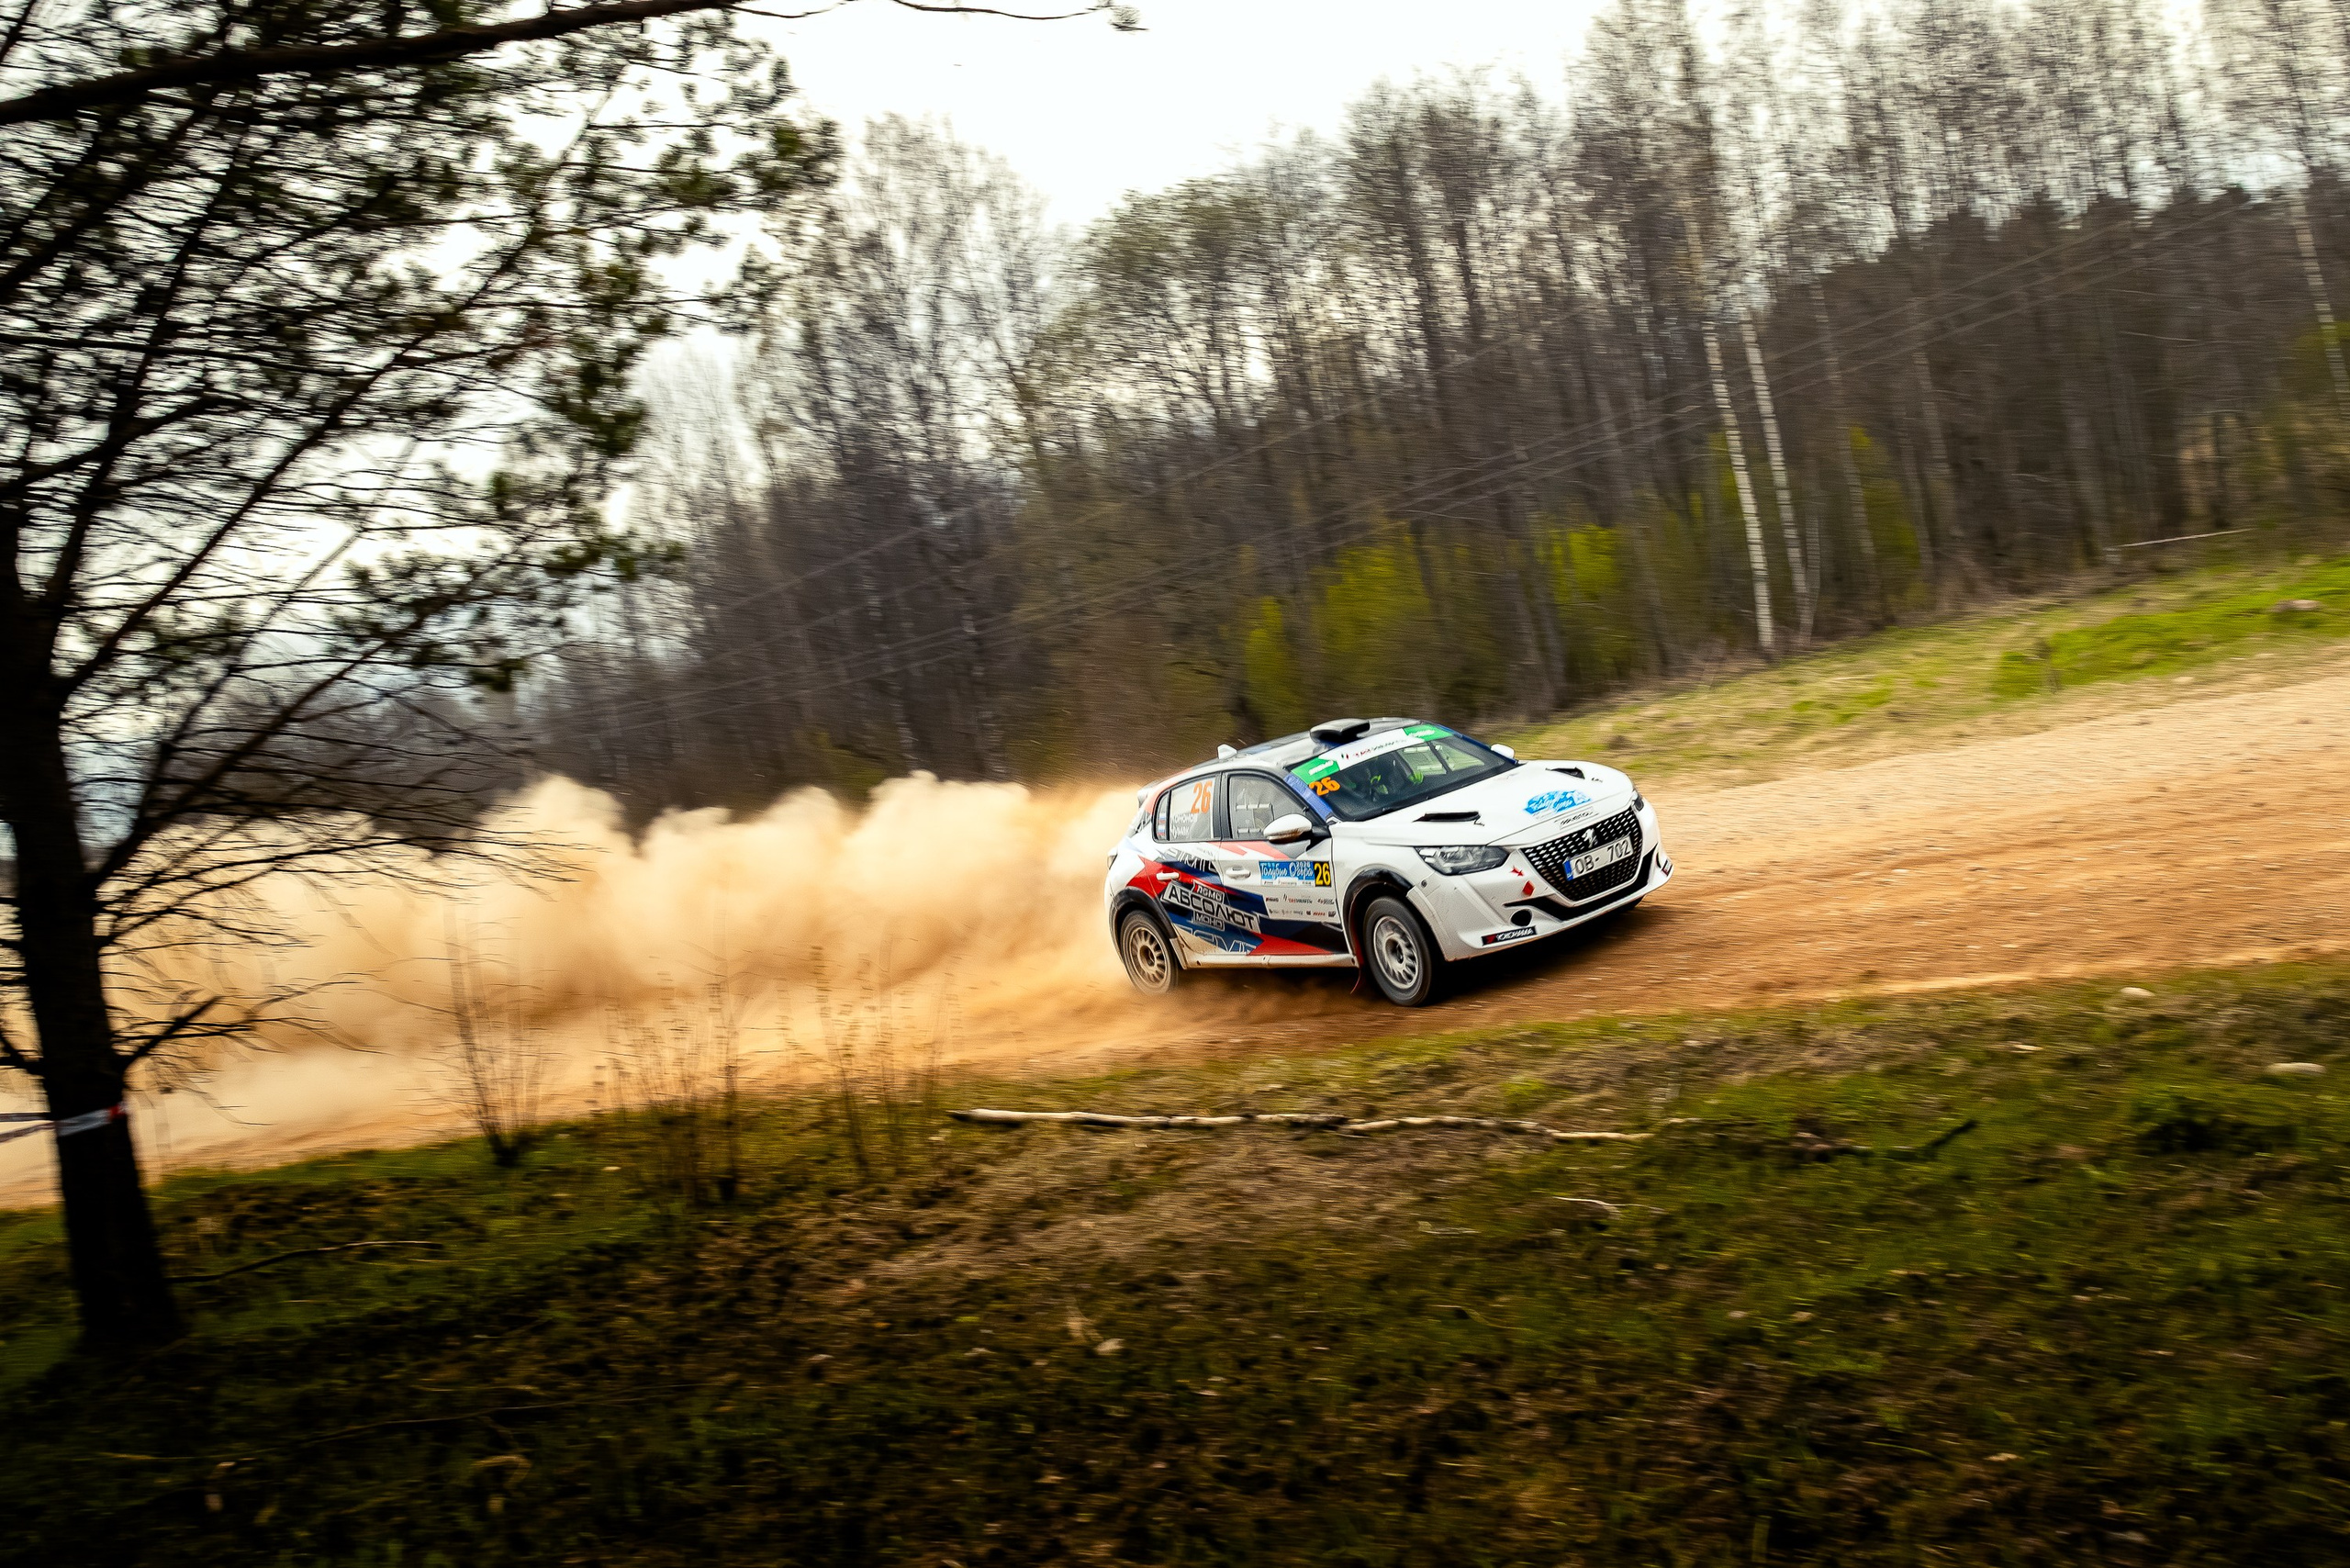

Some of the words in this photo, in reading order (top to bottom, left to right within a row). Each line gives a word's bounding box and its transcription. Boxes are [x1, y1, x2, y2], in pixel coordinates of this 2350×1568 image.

[1191, 780, 1213, 814] 26
[1309, 777, 1340, 796] 26
[1606, 839, 1631, 863] 702
[1314, 862, 1331, 886] 26
[1168, 885, 1255, 930] АБСОЛЮТ
[1195, 912, 1223, 928] МОНО
